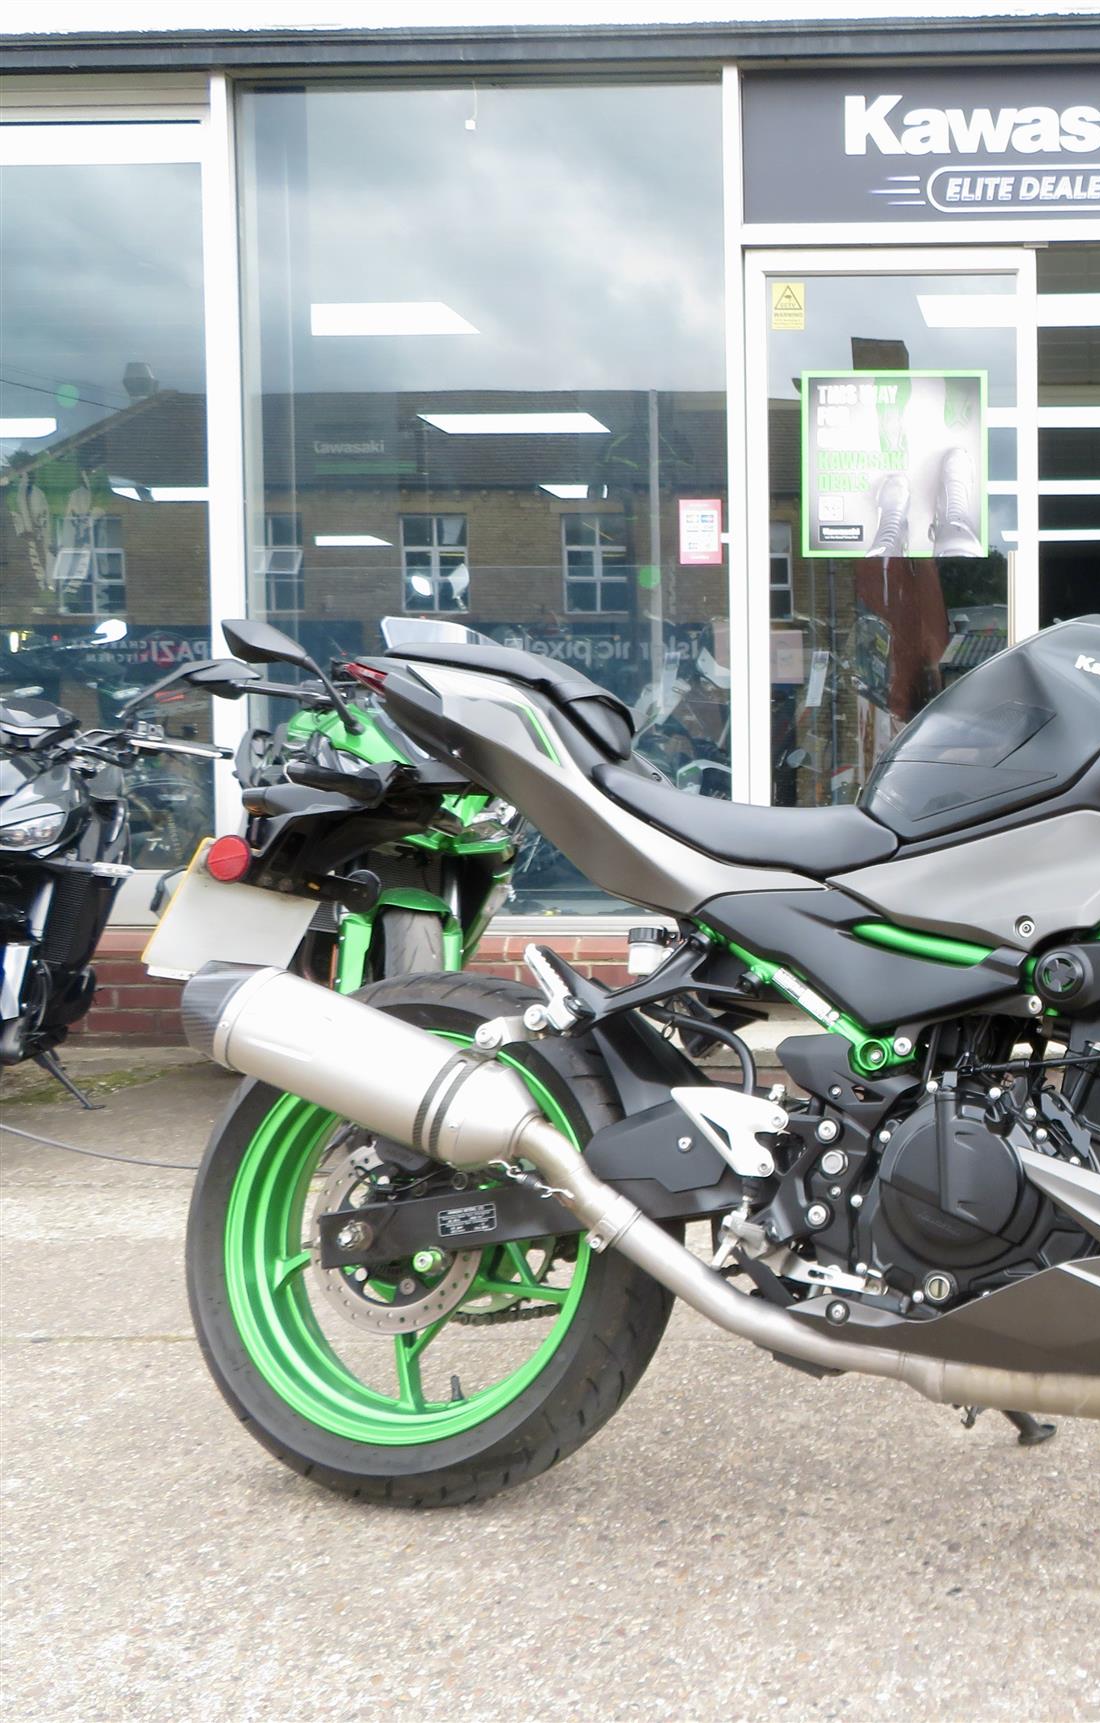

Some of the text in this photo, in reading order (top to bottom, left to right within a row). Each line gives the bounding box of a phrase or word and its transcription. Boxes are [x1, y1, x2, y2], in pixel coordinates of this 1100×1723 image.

[946, 176, 1015, 201] ELITE
[816, 450, 909, 471] KAWASAKI
[816, 473, 871, 493] DEALS
